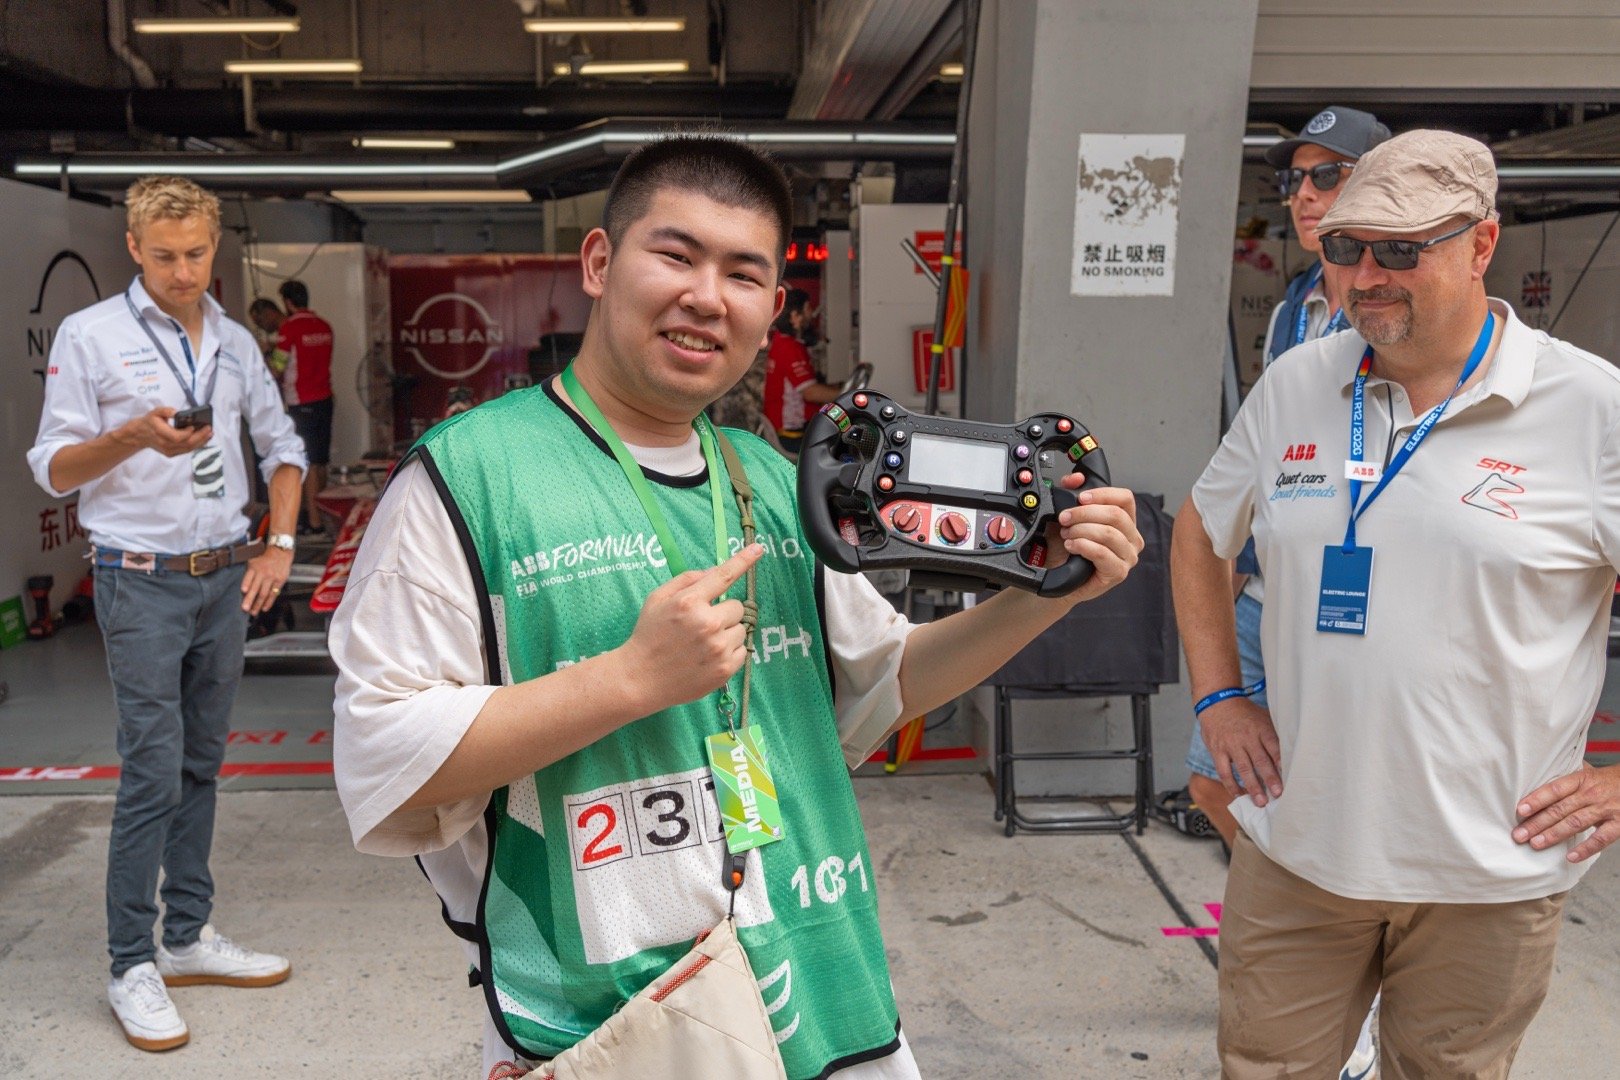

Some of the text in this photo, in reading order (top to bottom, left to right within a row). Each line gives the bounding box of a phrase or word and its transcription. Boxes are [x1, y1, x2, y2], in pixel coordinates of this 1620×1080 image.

[1083, 244, 1166, 263] 禁止吸烟
[1082, 266, 1165, 277] NO SMOKING
[400, 328, 503, 344] NISSAN
[1355, 376, 1366, 395] SHA
[1354, 401, 1364, 421] R12
[1405, 413, 1439, 452] ELECTRIC
[1282, 444, 1316, 462] ABB
[1353, 466, 1375, 476] ABB
[1476, 457, 1527, 475] SRT
[1301, 474, 1327, 484] cars
[1291, 485, 1337, 502] friends
[511, 551, 551, 580] ABB
[551, 532, 647, 571] FORMULA
[1031, 545, 1043, 566] REGE
[516, 562, 647, 596] FIA WORLD CHAMPIONSHIP
[730, 744, 763, 833] MEDIA
